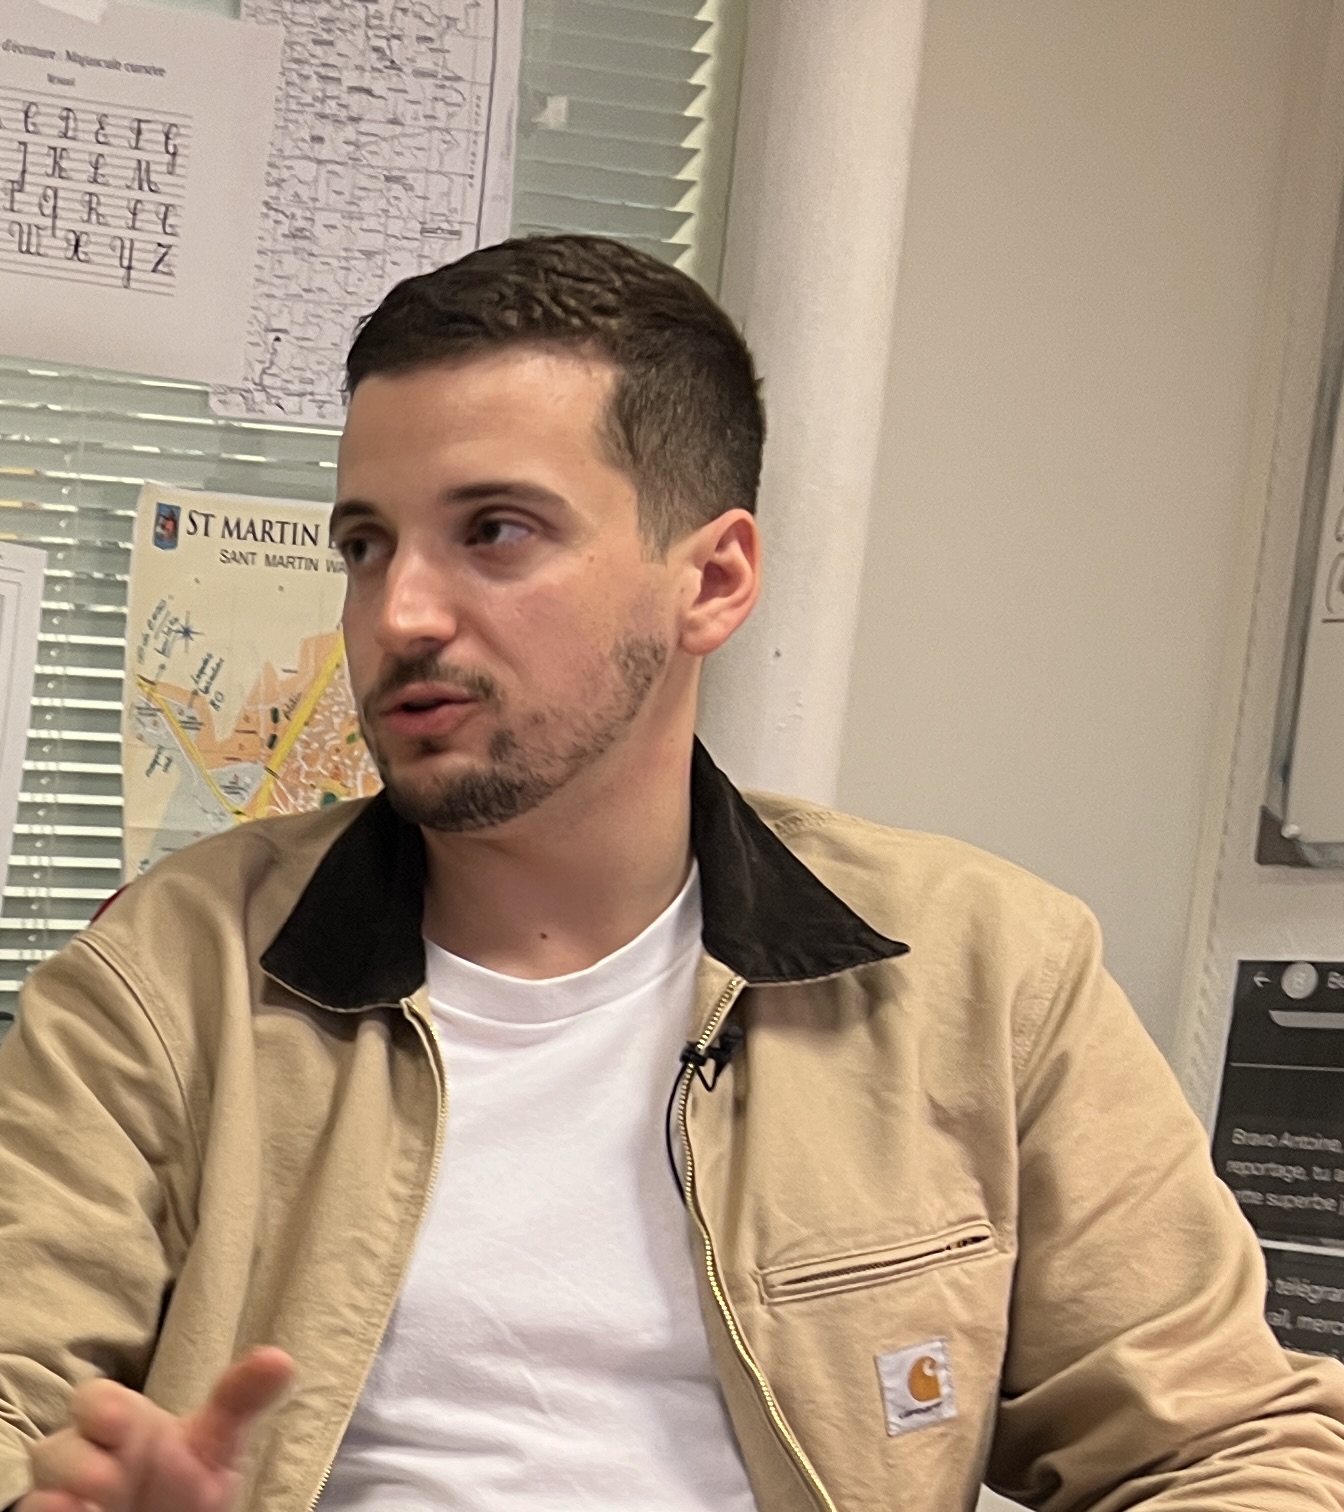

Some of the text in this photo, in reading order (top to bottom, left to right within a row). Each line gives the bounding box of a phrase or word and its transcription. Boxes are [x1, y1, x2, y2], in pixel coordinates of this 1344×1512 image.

[24, 102, 39, 133] C
[59, 107, 78, 140] D
[95, 113, 109, 145] E
[163, 123, 180, 174] G
[45, 146, 70, 179] K
[88, 153, 111, 186] L
[126, 159, 160, 193] M
[81, 192, 109, 225] R
[9, 221, 50, 256] W
[64, 229, 91, 262] X
[109, 236, 134, 288] Y
[151, 242, 174, 275] Z
[186, 509, 320, 547] ST MARTIN
[219, 549, 257, 566] SANT
[264, 553, 319, 572] MARTIN
